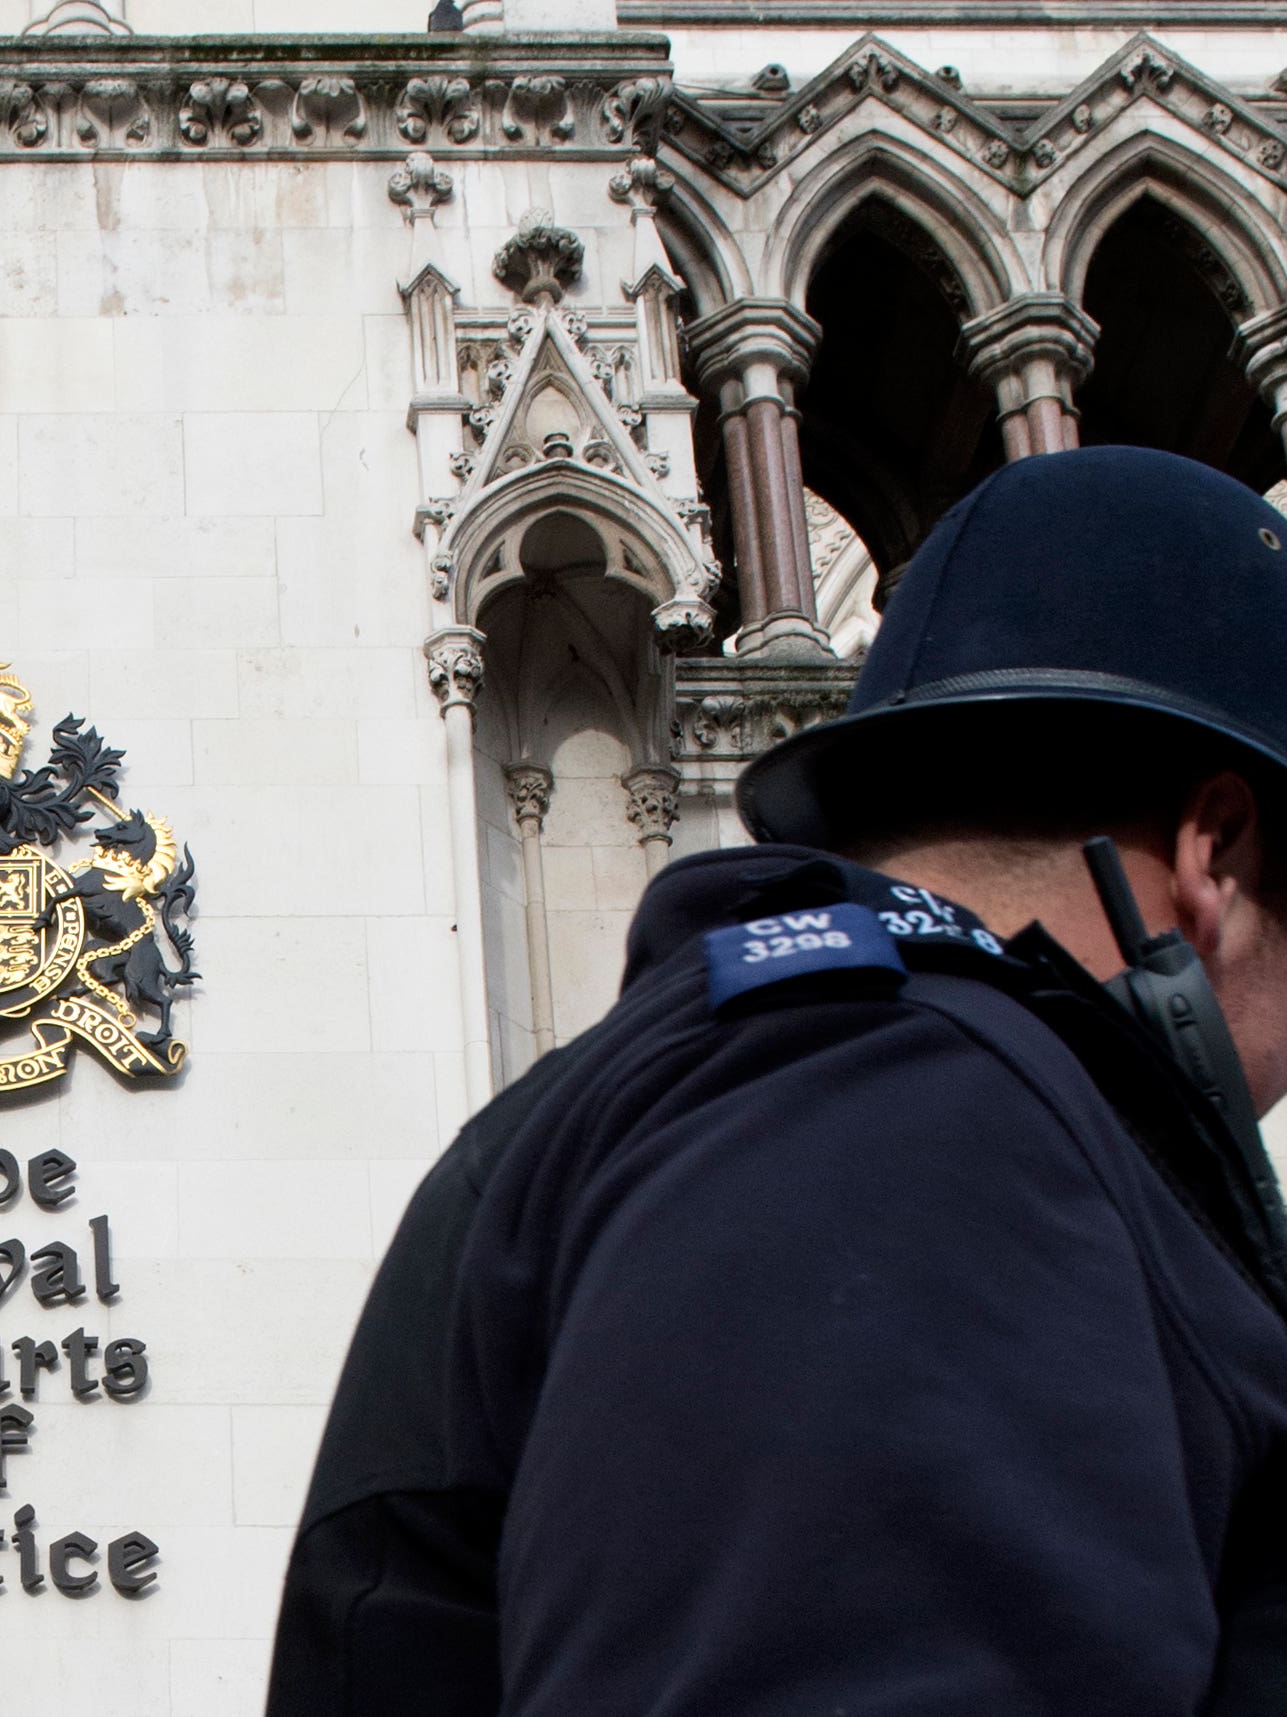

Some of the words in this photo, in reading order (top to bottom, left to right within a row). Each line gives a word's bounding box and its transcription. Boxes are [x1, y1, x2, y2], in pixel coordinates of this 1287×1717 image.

[742, 930, 852, 963] 3298
[745, 913, 832, 936] CW
[878, 910, 1003, 955] 328
[29, 923, 80, 994] PENSE
[50, 999, 148, 1069] DROIT
